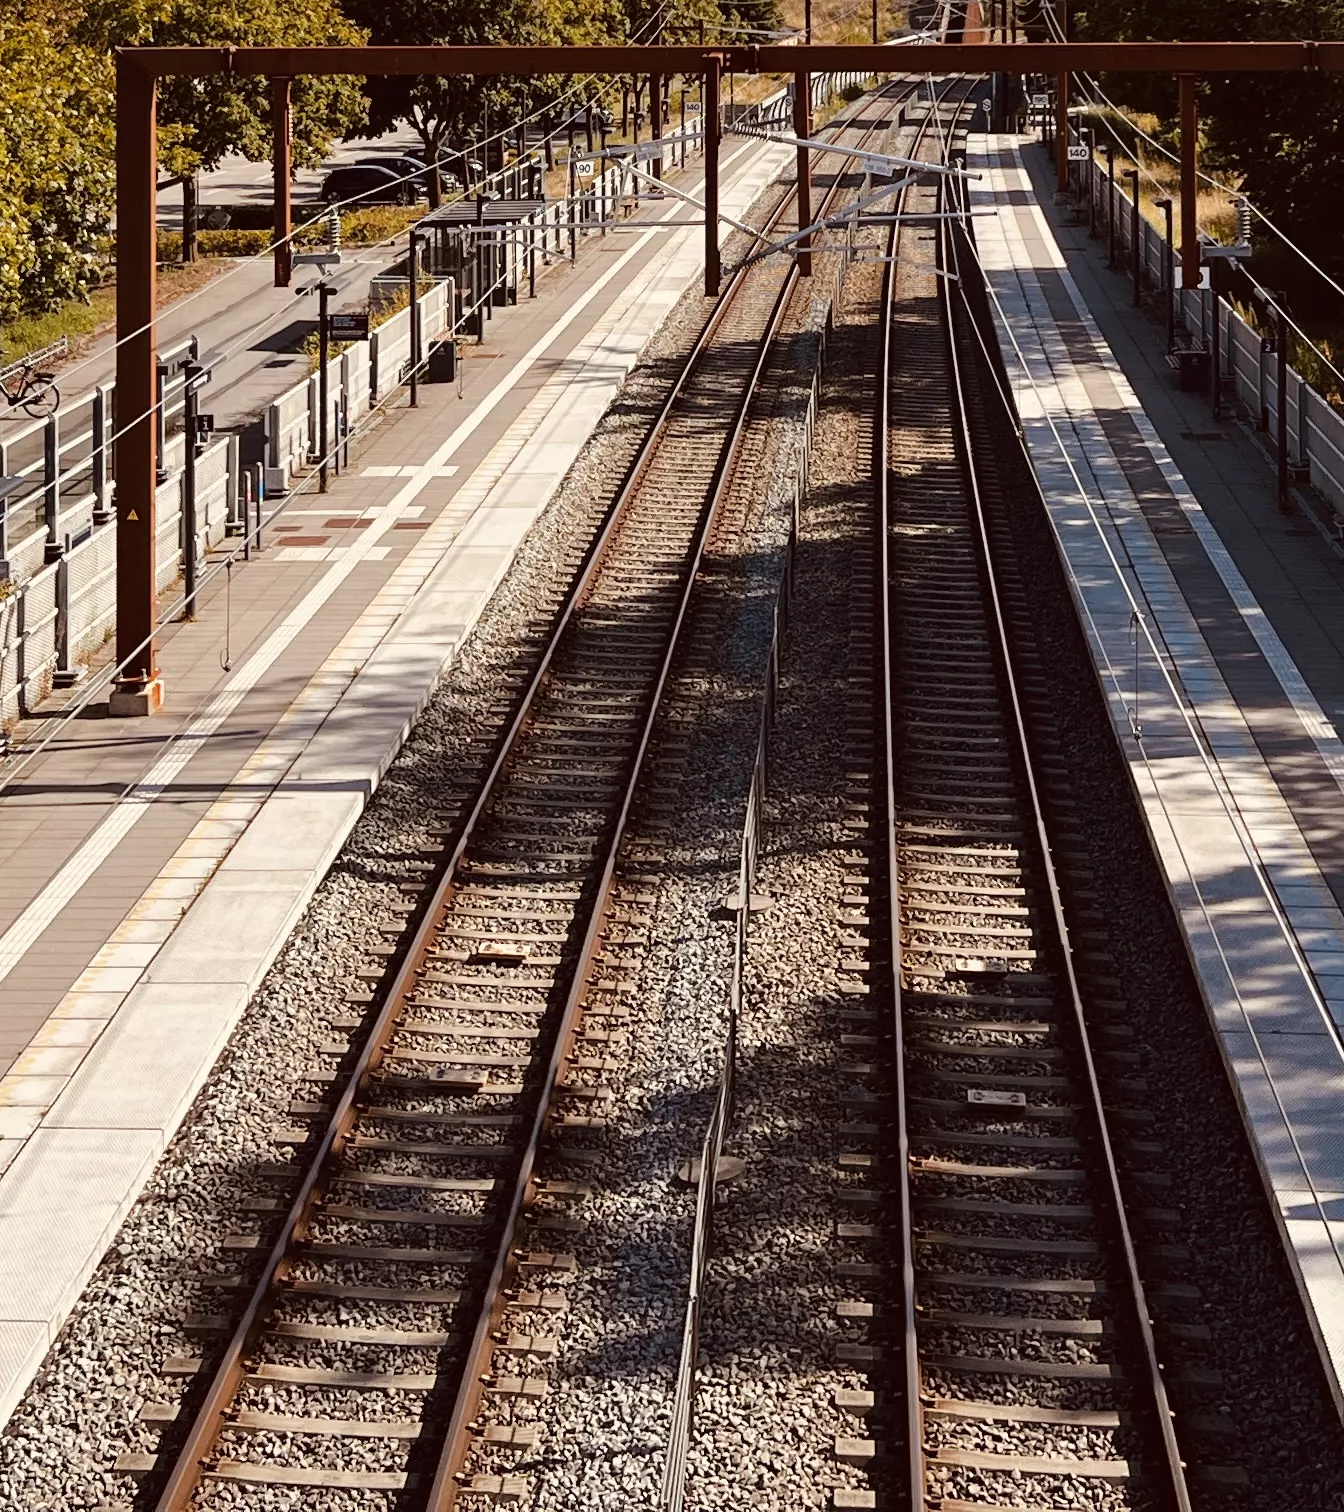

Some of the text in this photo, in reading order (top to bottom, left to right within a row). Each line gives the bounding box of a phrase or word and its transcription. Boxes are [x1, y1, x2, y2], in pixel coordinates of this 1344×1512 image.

[686, 103, 699, 111] 140
[1069, 149, 1087, 157] 140
[579, 164, 591, 173] 90
[1265, 344, 1271, 352] 2
[202, 421, 209, 430] 1
